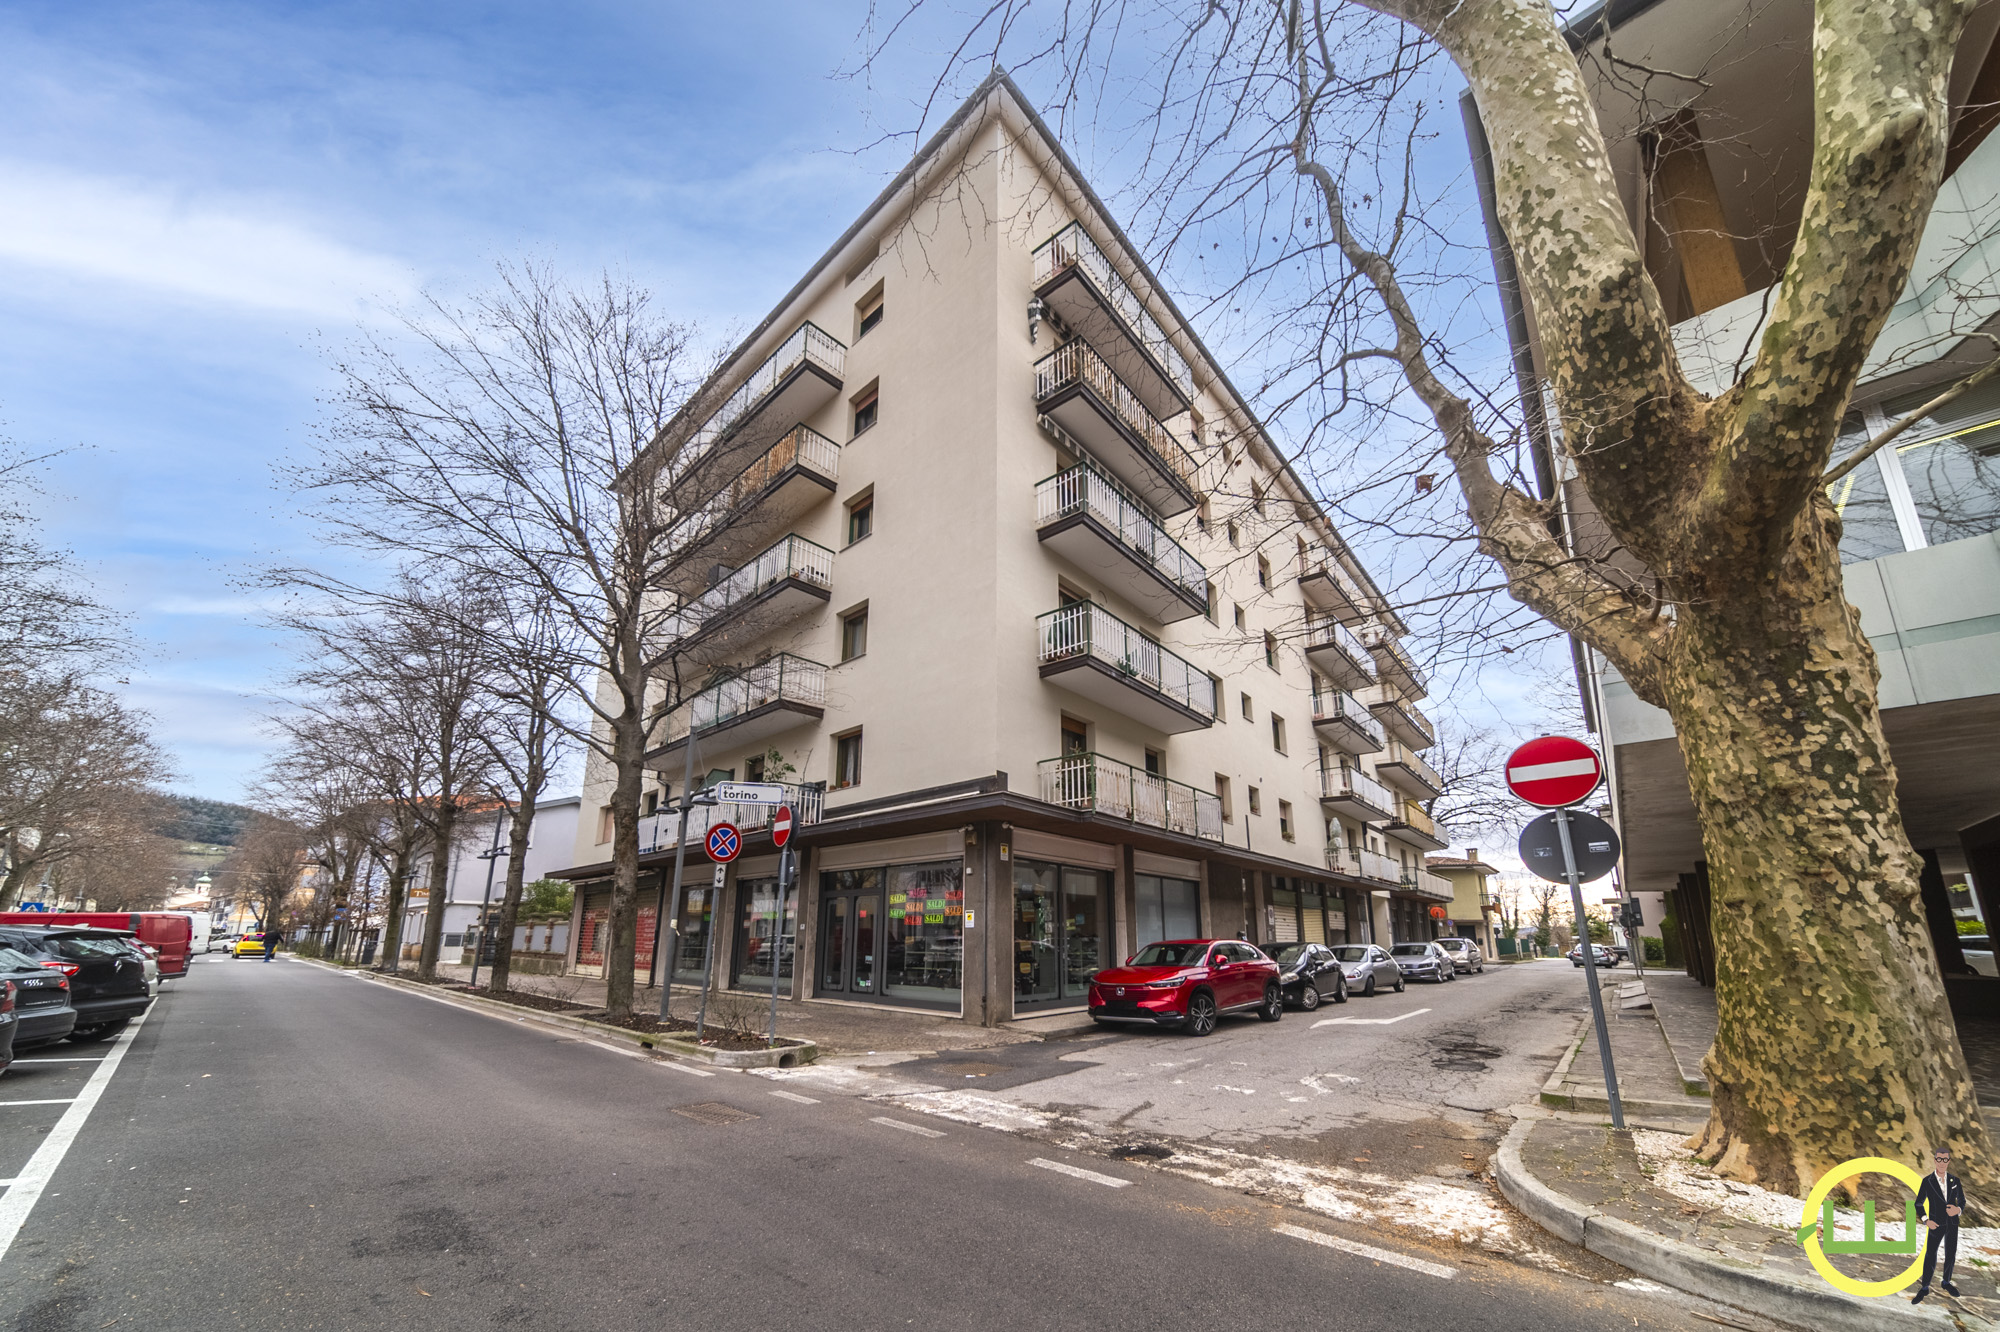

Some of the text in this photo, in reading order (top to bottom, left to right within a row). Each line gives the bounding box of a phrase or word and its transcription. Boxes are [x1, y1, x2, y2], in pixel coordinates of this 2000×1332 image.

[723, 790, 758, 800] torino
[890, 894, 906, 903] SALDI
[906, 903, 923, 911] SALDI
[927, 900, 945, 909] SALDI
[890, 909, 906, 918] SALDI
[925, 914, 943, 922] SALDI
[905, 915, 922, 924] SALDI
